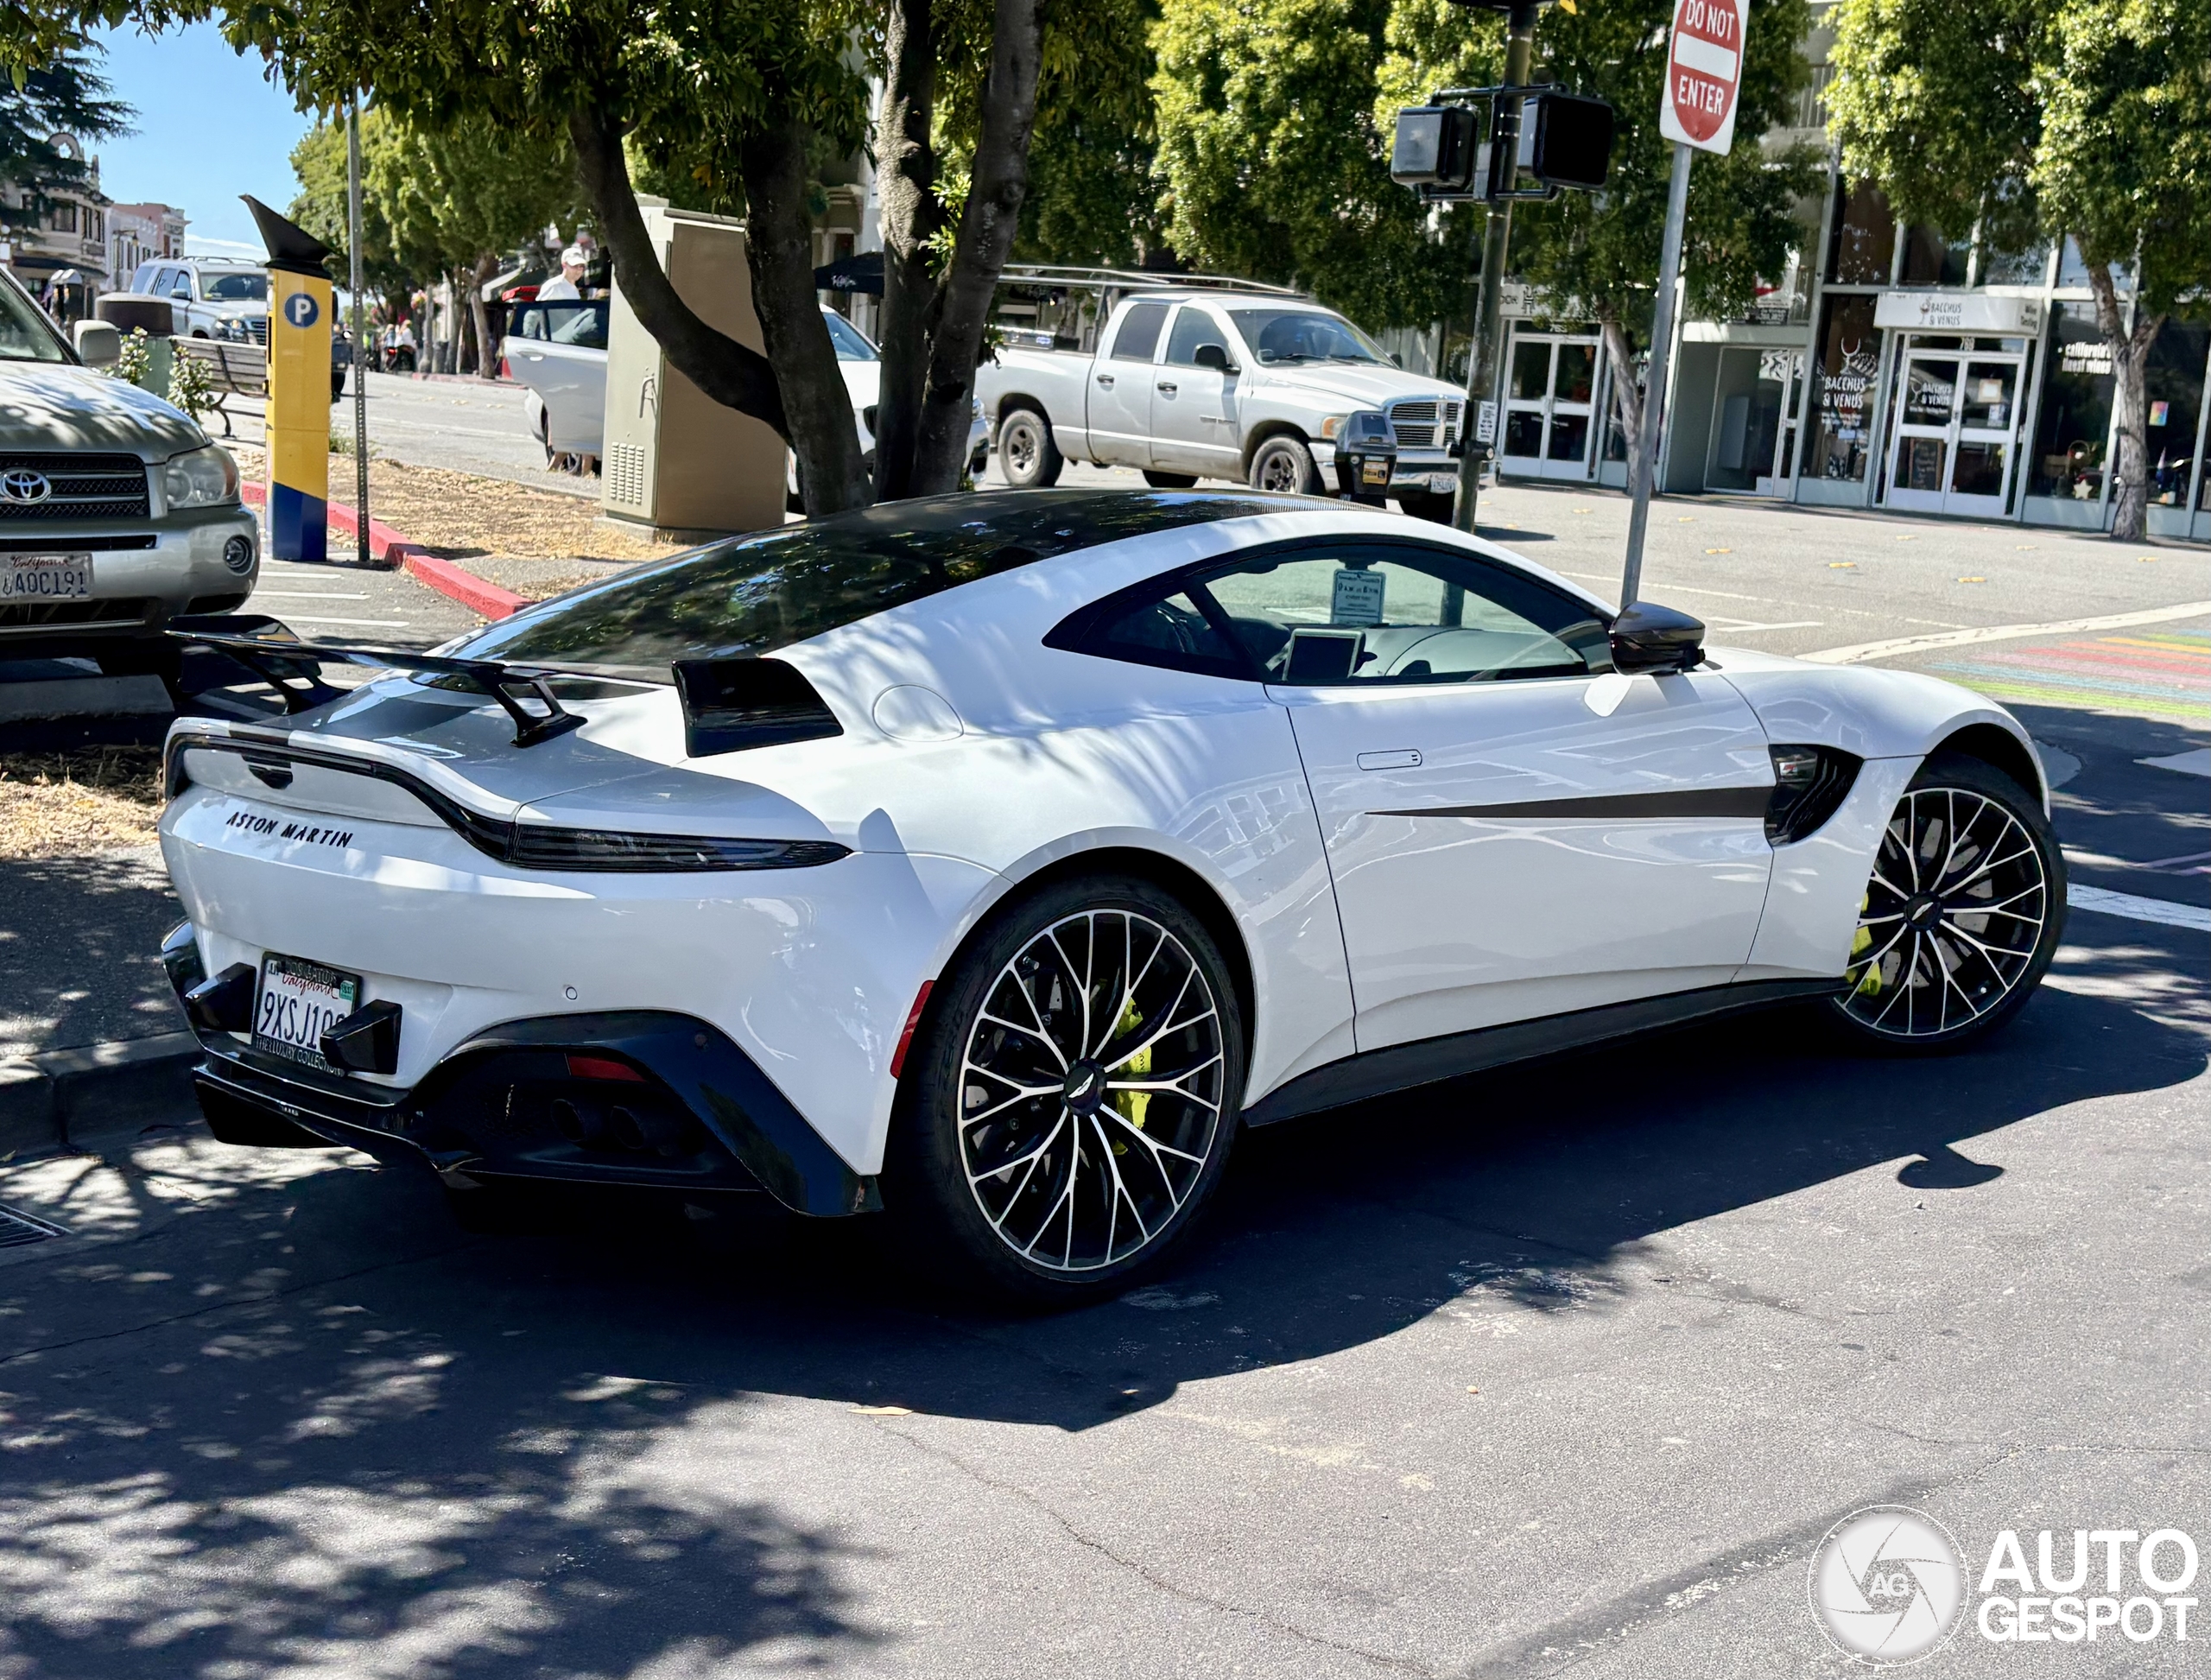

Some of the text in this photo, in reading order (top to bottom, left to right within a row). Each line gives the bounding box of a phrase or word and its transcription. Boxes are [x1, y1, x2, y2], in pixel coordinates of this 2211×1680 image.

[1686, 0, 1735, 41] DO NOT
[1678, 74, 1725, 116] ENTER
[295, 298, 312, 323] P
[1931, 301, 1962, 314] BACCHUS
[1929, 314, 1961, 326] & VENUS
[2086, 358, 2113, 375] wines
[1824, 376, 1866, 392] BACCHUS
[1822, 392, 1864, 409] & VENUS
[226, 811, 353, 848] ASTON MARTIN
